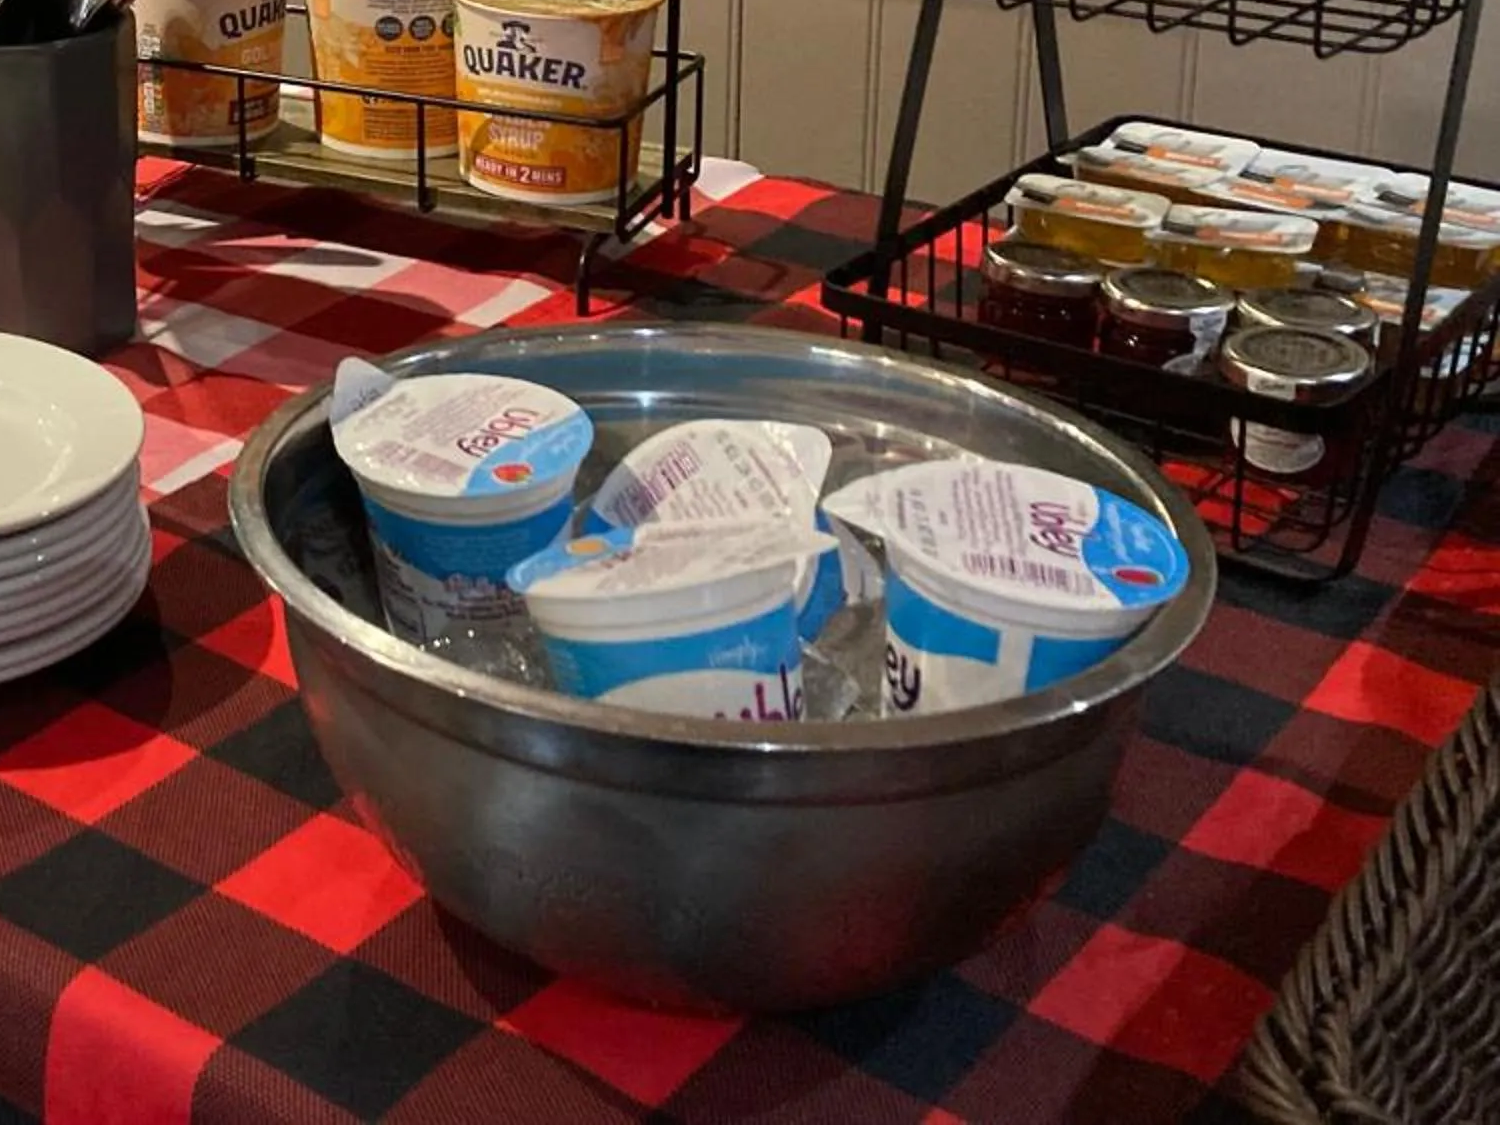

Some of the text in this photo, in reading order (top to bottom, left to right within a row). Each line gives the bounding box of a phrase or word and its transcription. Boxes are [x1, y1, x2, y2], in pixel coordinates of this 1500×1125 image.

[219, 0, 286, 40] QUAK
[462, 44, 586, 90] QUAKER
[488, 123, 545, 152] SYRUP
[519, 165, 531, 184] 2
